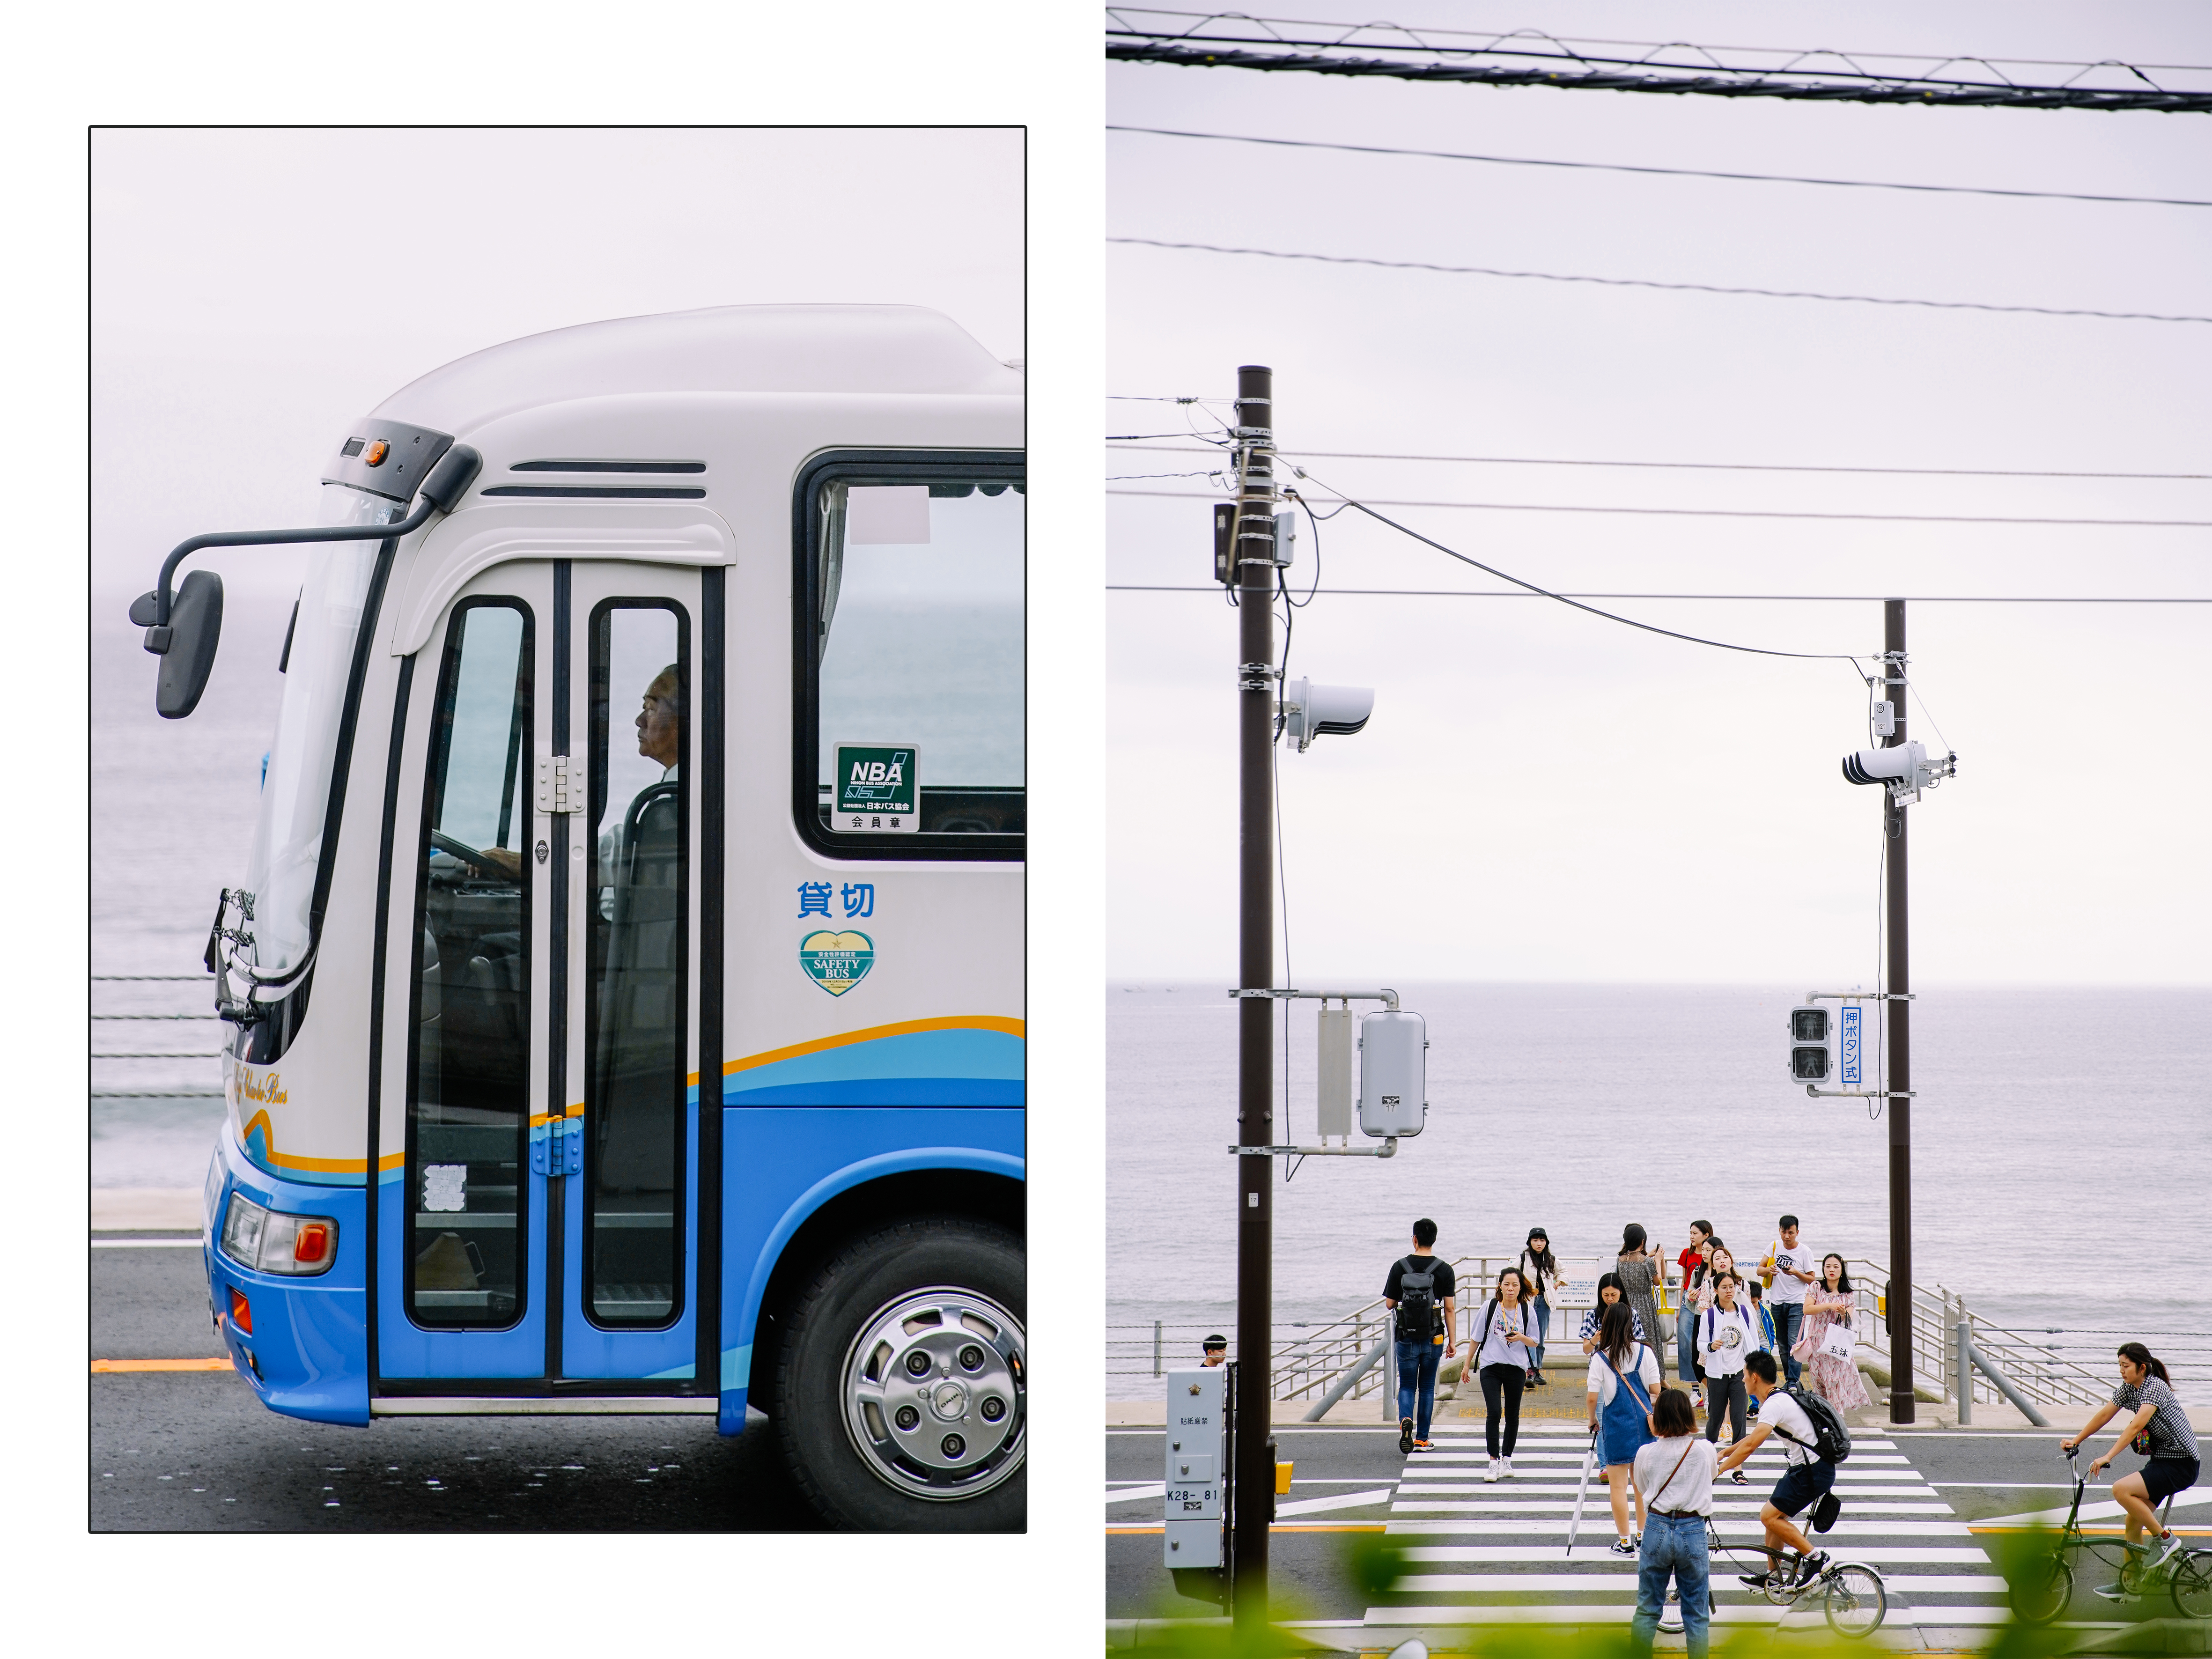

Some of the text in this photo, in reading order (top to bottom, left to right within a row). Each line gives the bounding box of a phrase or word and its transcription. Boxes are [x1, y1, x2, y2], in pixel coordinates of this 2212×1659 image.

[851, 762, 902, 782] NBA
[867, 802, 910, 811] 日本バス協会
[852, 816, 900, 828] 会員章
[797, 882, 874, 918] 貸切
[813, 959, 860, 969] SAFETY
[825, 969, 849, 978] BUS
[1845, 1012, 1857, 1078] 押ボタン式
[265, 1073, 288, 1105] Bus
[1829, 1345, 1848, 1357] 五沐
[1204, 1490, 1217, 1500] 81
